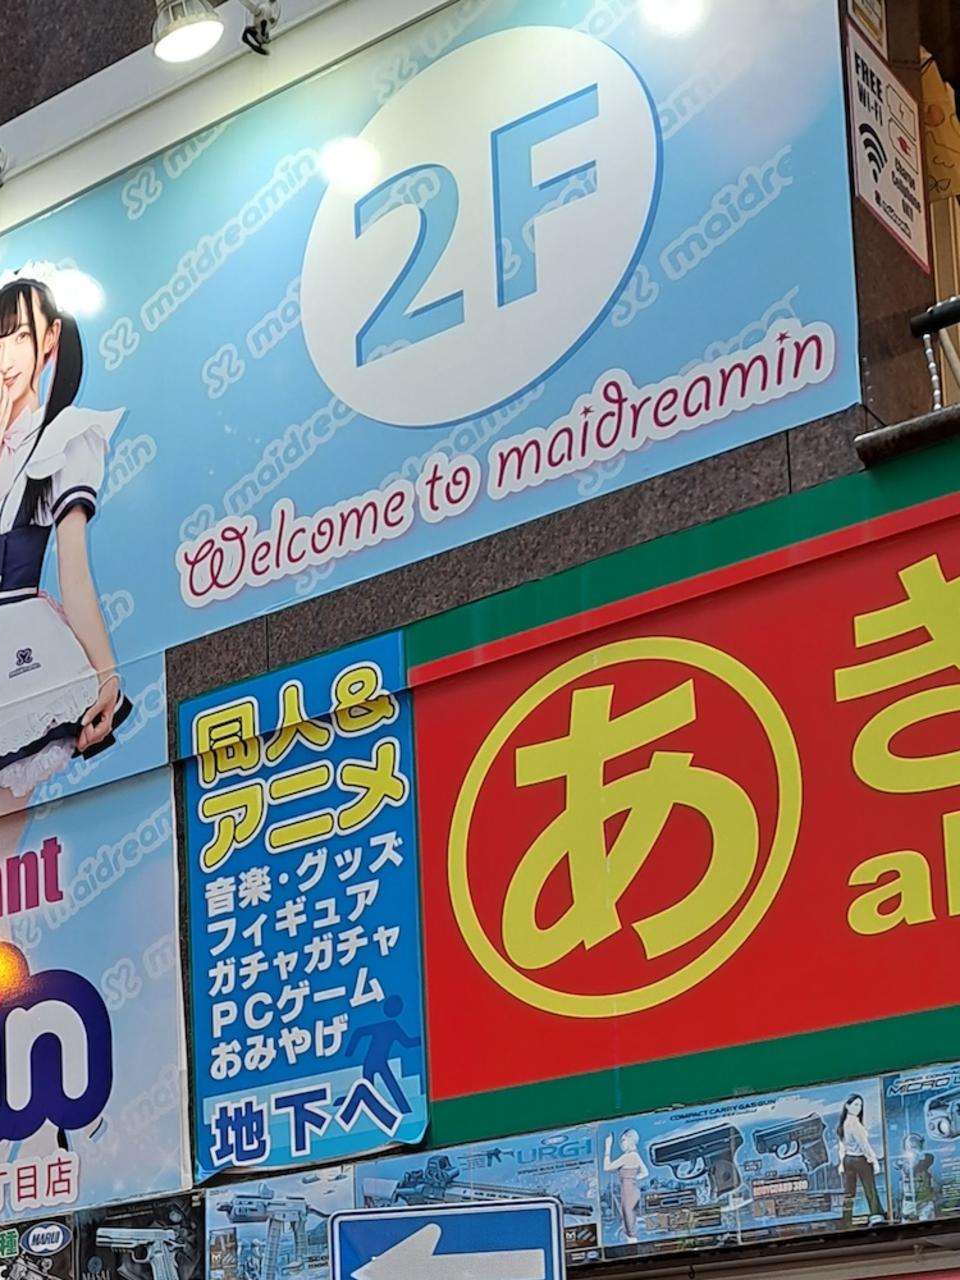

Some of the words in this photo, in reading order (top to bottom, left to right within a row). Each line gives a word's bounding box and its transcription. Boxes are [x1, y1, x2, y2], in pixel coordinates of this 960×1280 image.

[854, 52, 884, 102] FREE
[353, 82, 601, 370] 2F
[183, 490, 405, 598] Welcome
[424, 466, 471, 508] to
[496, 329, 825, 488] maidreamin
[195, 667, 394, 784] 同人&
[201, 742, 404, 868] アニメ
[502, 678, 760, 970] あ
[205, 832, 404, 914] 音楽・グッズ
[207, 880, 380, 957] フィギュア
[208, 926, 401, 998] ガチャガチャ
[211, 967, 385, 1039] PCゲーム
[209, 1014, 349, 1080] おみやげ
[210, 1076, 402, 1168] 地下へ
